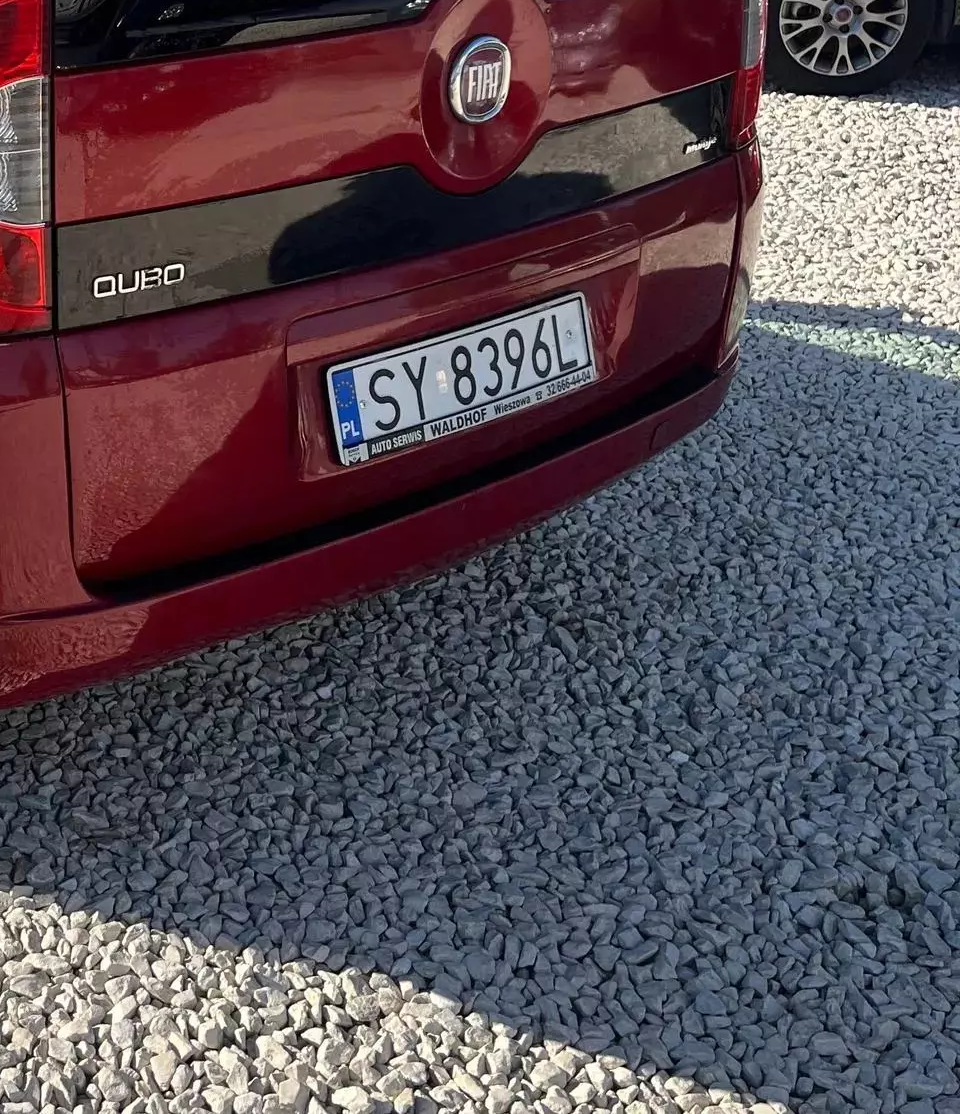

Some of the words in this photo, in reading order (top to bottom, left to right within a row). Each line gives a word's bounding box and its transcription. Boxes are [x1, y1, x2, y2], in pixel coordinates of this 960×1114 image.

[467, 61, 502, 103] FIAT
[94, 263, 185, 298] QUBO
[368, 356, 427, 431] SY
[450, 314, 578, 405] 8396L
[341, 420, 360, 440] PL
[371, 438, 392, 455] AUTO
[393, 430, 422, 448] SERWIS
[430, 408, 487, 437] WALDHOF
[494, 396, 531, 415] Wieszowa
